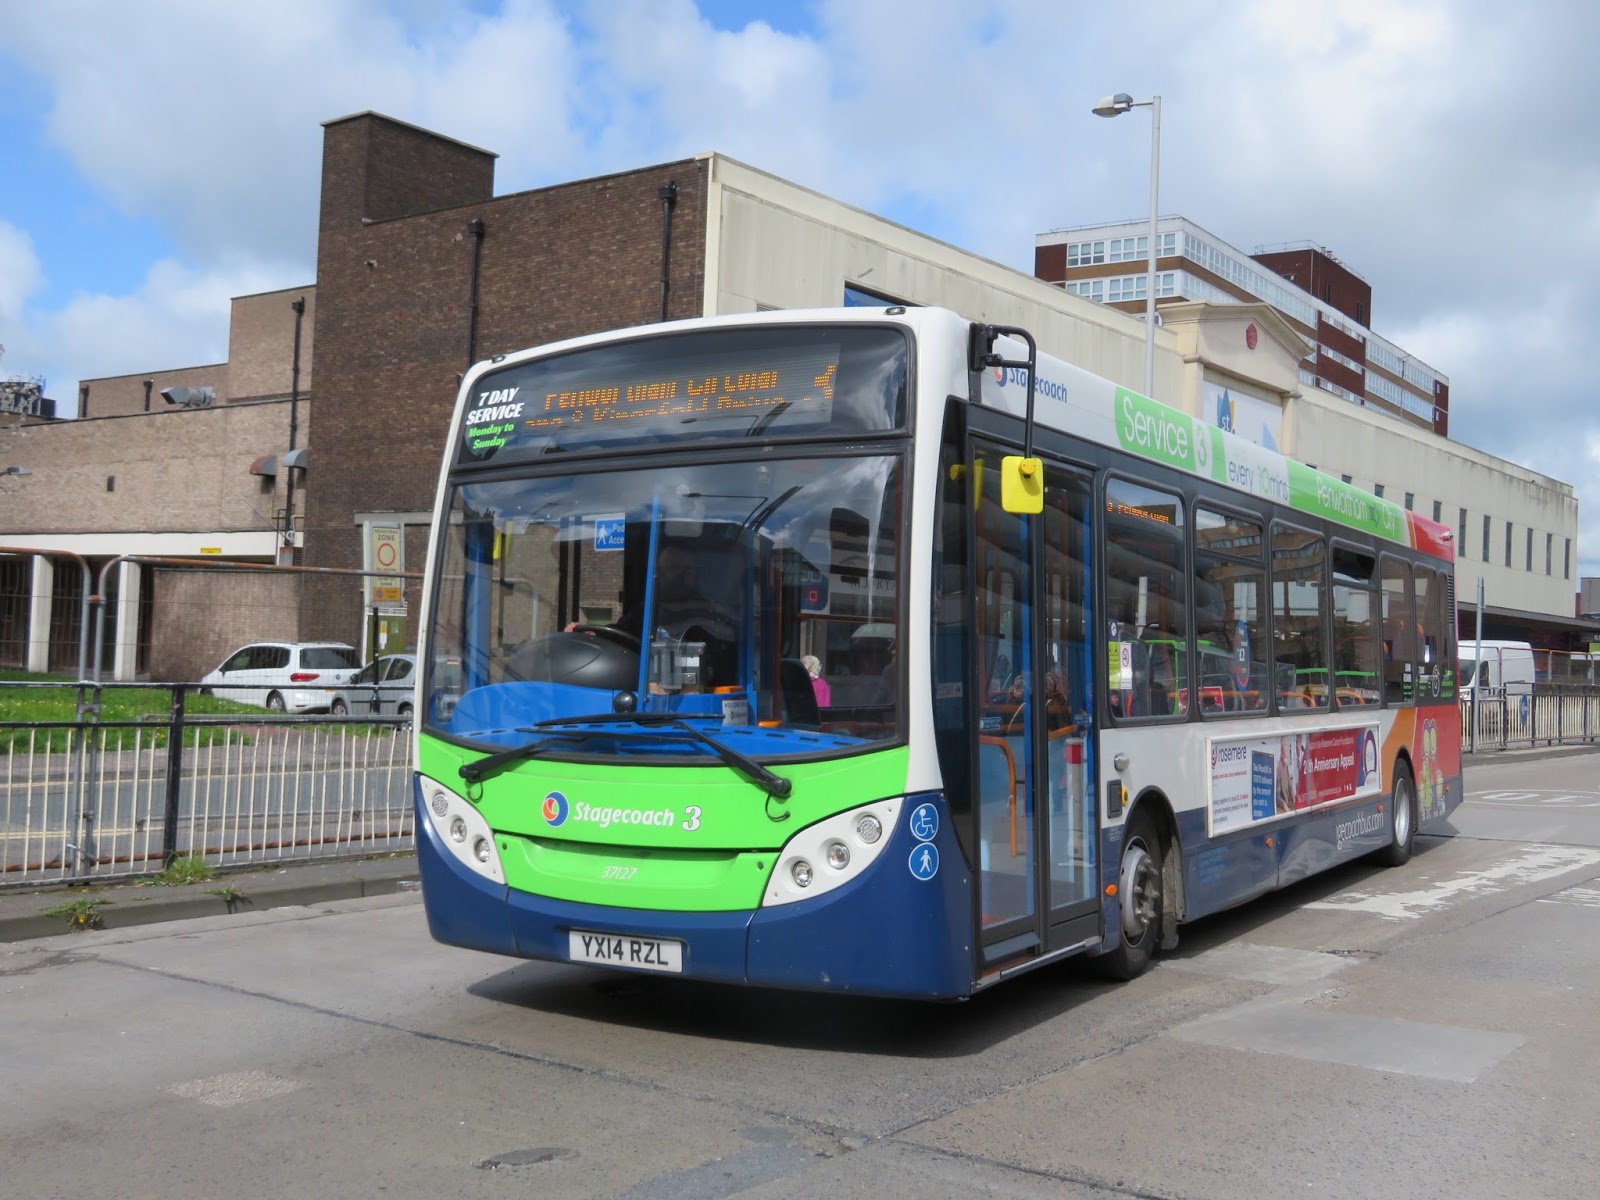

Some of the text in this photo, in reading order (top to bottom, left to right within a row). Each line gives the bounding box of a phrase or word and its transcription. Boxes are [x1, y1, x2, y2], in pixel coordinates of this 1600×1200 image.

[478, 387, 520, 407] 7 DAY
[1010, 368, 1067, 403] Staecoach
[466, 402, 525, 425] SERVICE
[468, 423, 514, 438] Monday to
[1123, 395, 1207, 467] Service 3
[472, 436, 507, 449] Sunday
[1228, 461, 1254, 493] every
[1218, 746, 1247, 762] rosemere
[1303, 752, 1355, 775] 2th Anniversary Appeal
[574, 801, 702, 832] Stagecoach 3
[601, 865, 638, 880] 37127
[581, 935, 669, 966] YX14 RZL
